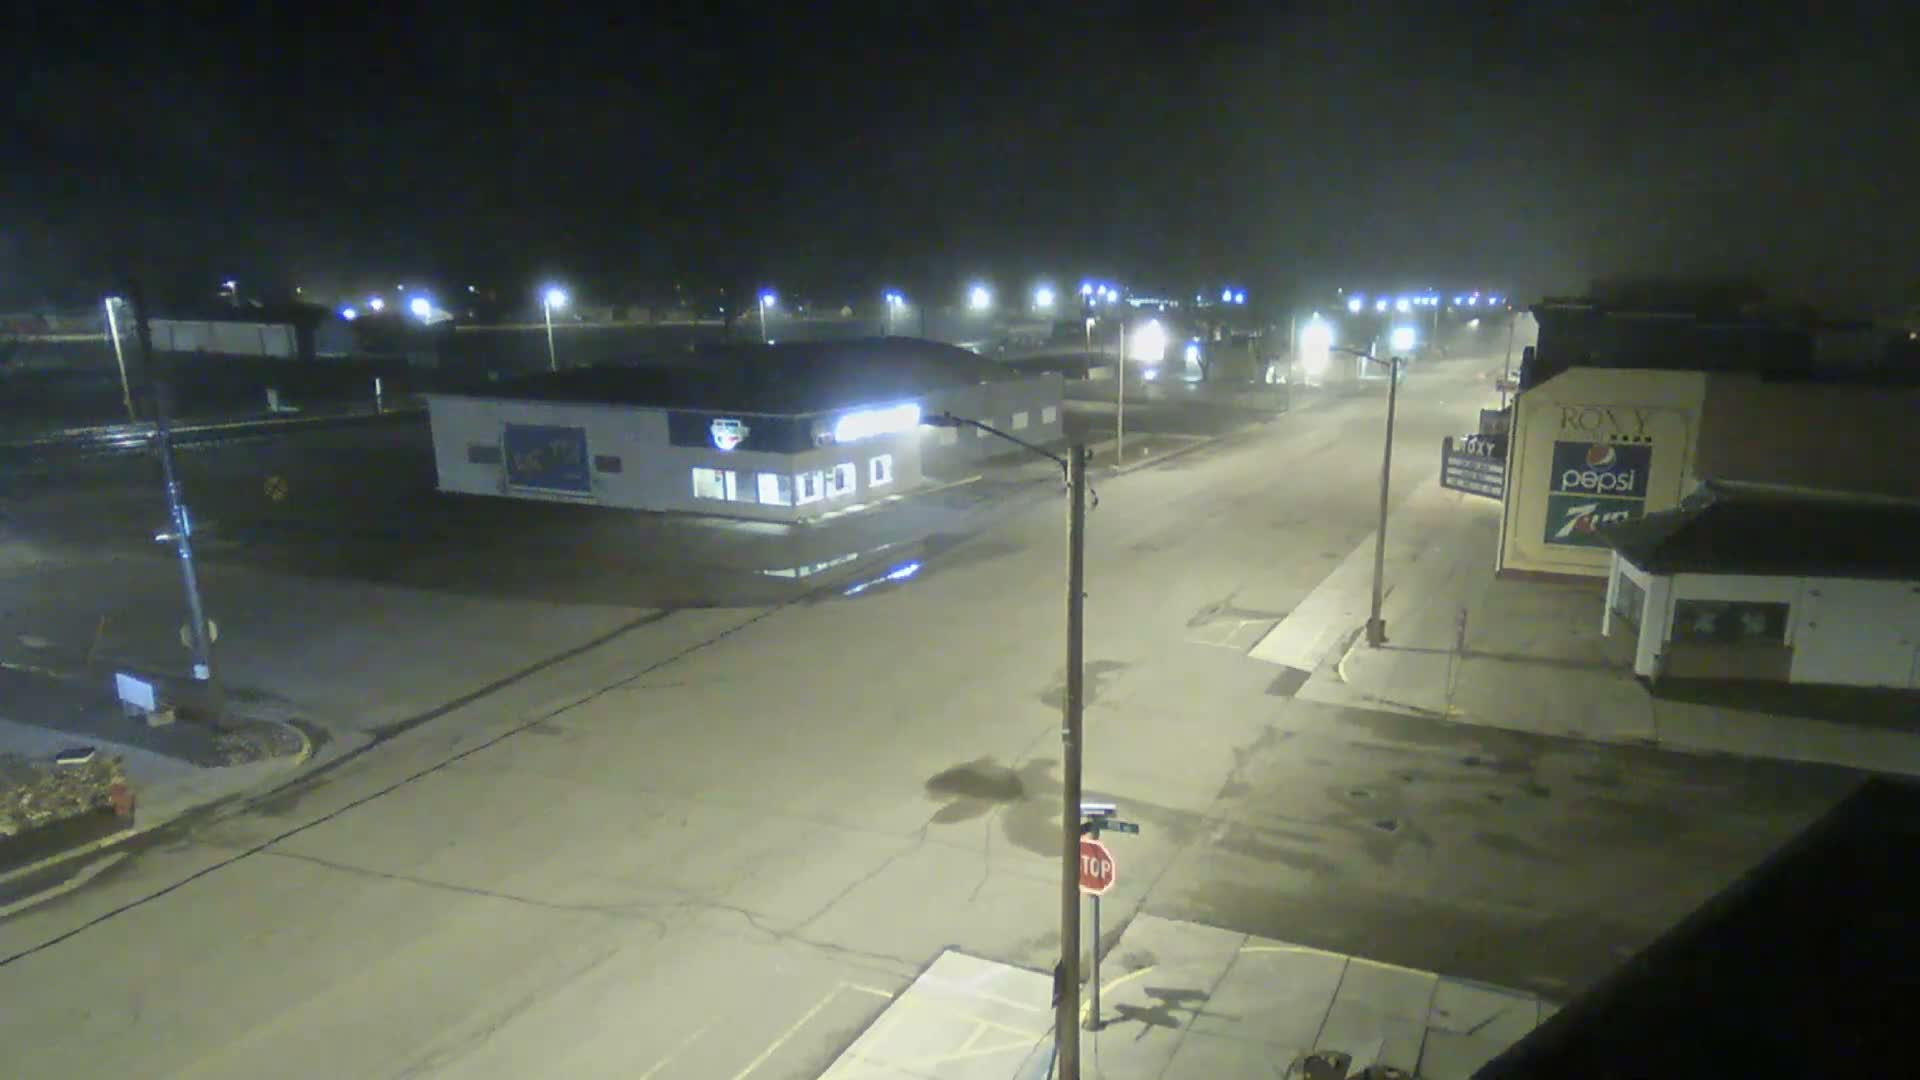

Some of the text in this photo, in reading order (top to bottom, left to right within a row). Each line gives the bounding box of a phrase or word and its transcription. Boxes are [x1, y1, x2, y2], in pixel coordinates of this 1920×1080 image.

[1560, 406, 1650, 434] ROXY
[1561, 468, 1635, 494] pepsi
[1081, 855, 1111, 880] TOP
